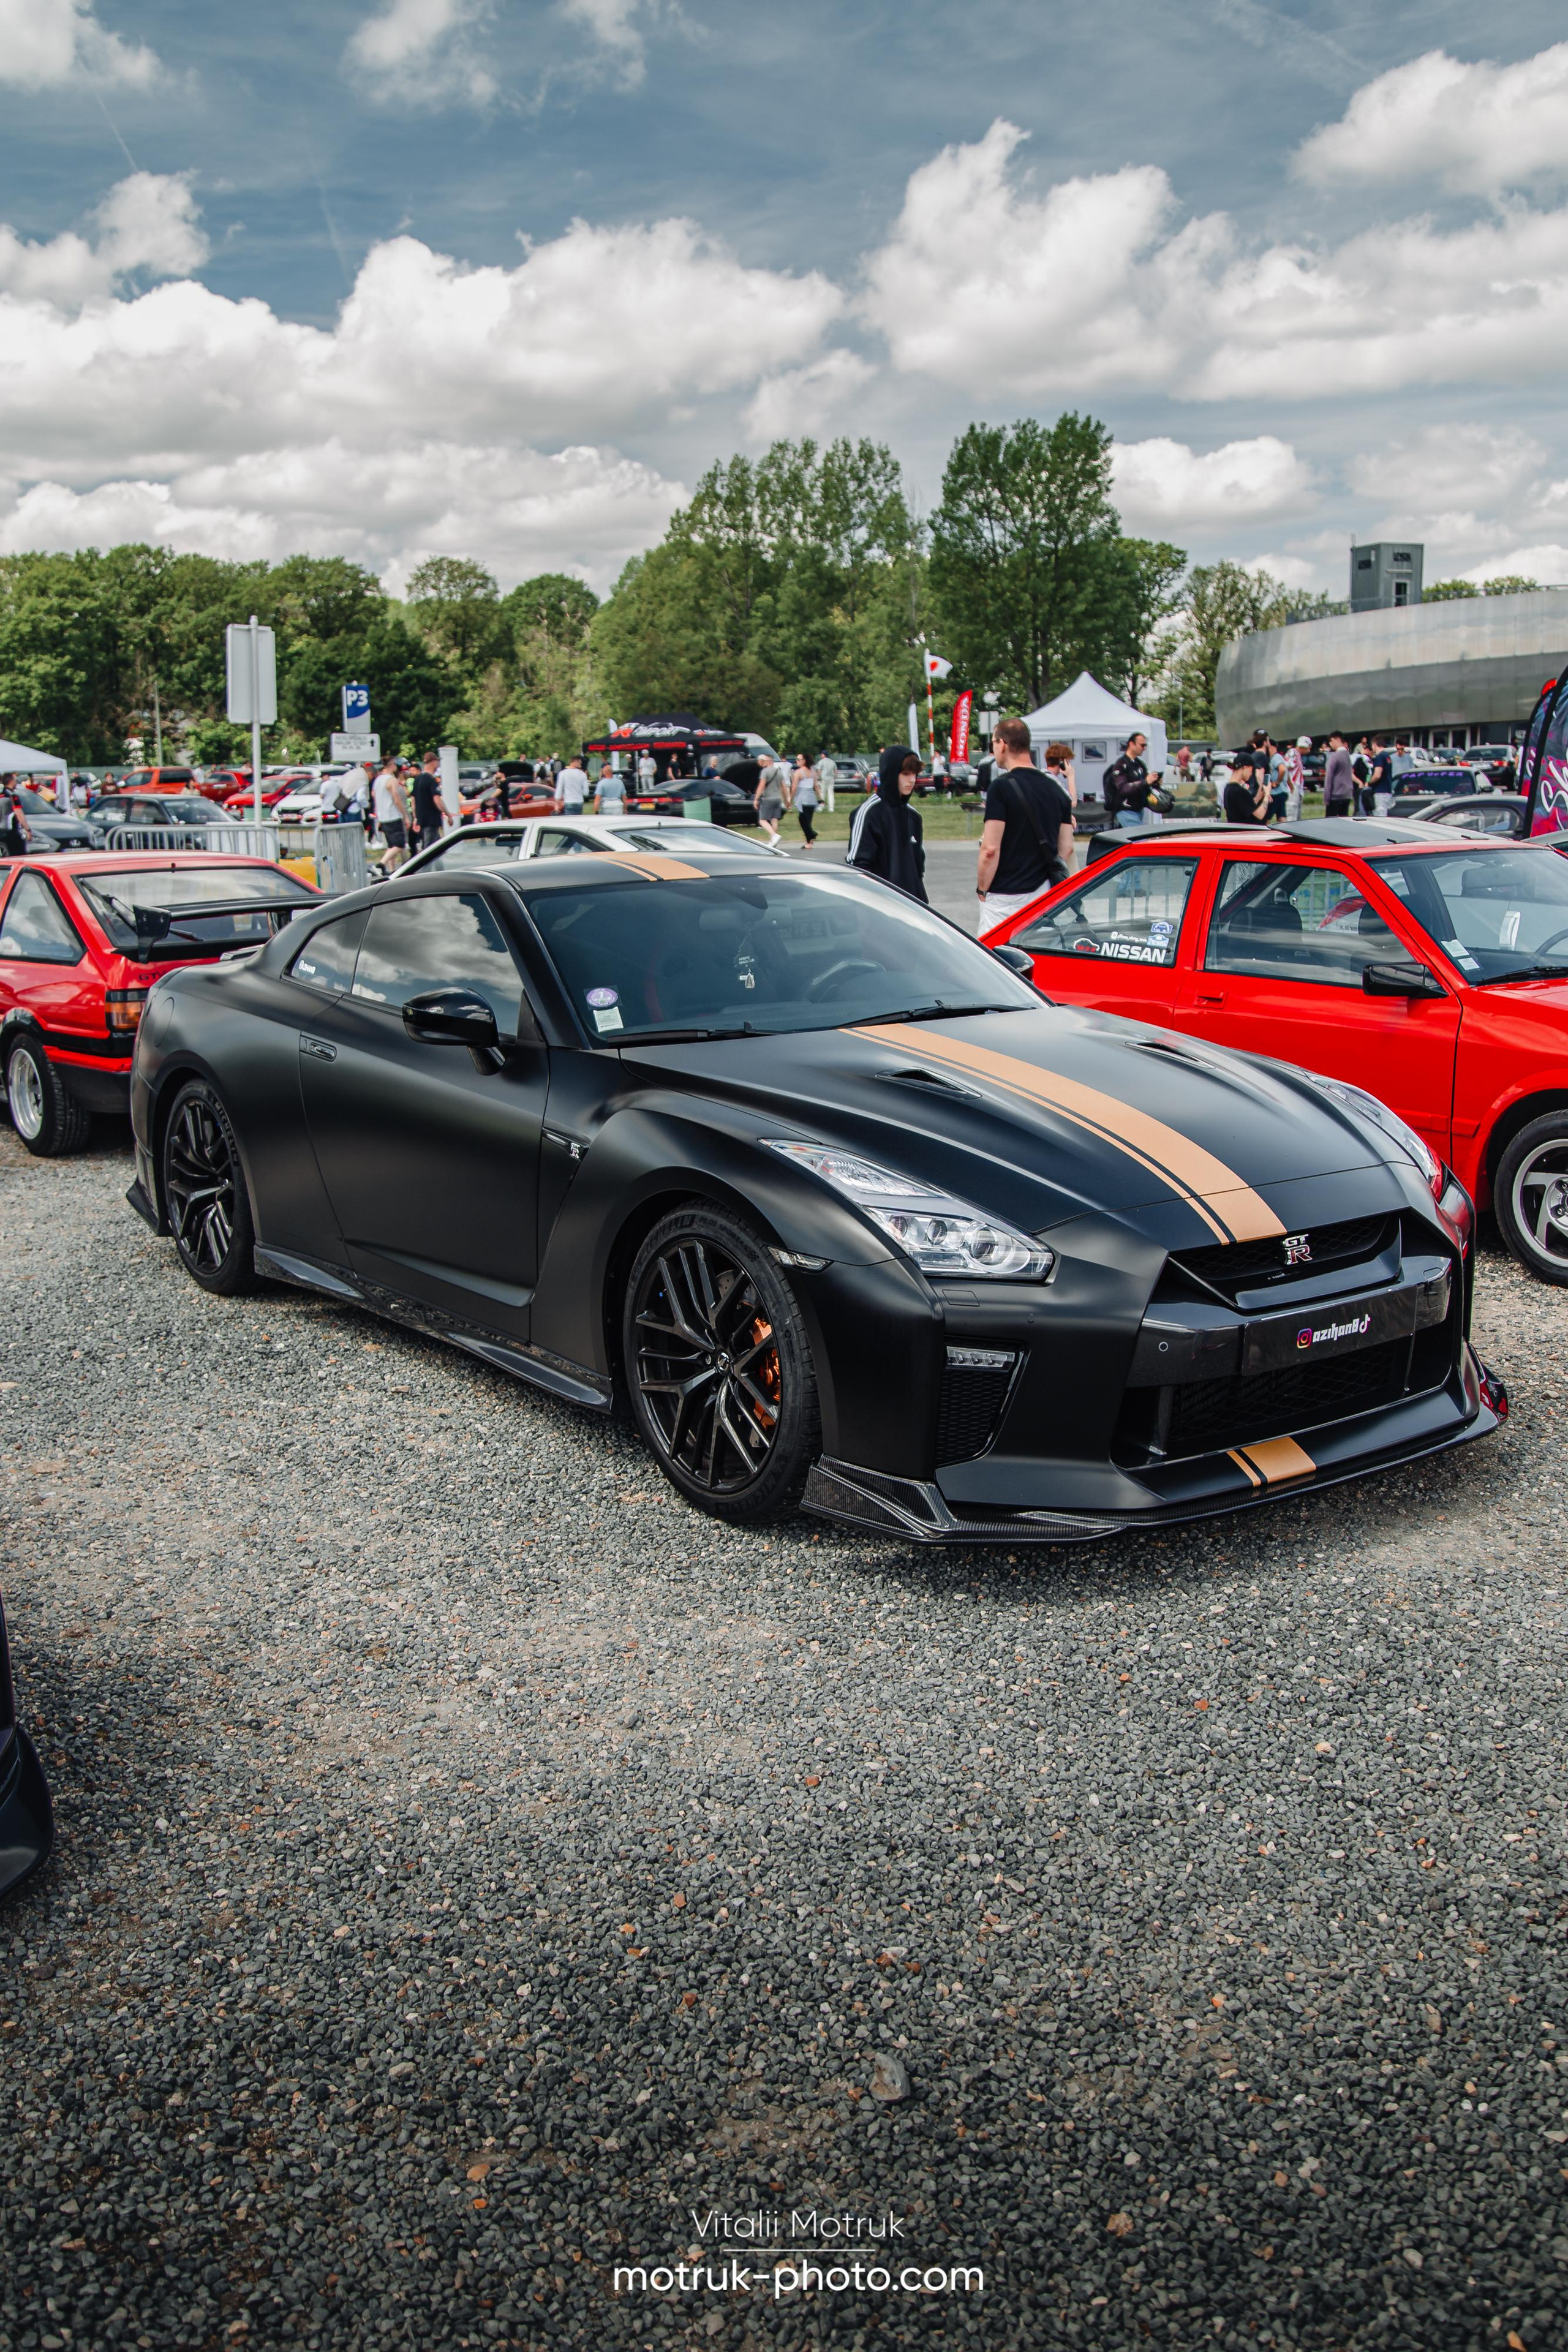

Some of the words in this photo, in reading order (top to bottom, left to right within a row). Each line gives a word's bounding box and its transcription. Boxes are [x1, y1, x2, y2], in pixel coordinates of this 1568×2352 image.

[346, 690, 368, 707] P3
[1101, 942, 1166, 963] NISSAN
[214, 1101, 238, 1162] MICHELIN
[699, 1216, 718, 1226] PILOT
[719, 1224, 741, 1241] SPORT
[1283, 1234, 1309, 1247] GT
[1284, 1244, 1313, 1265] R
